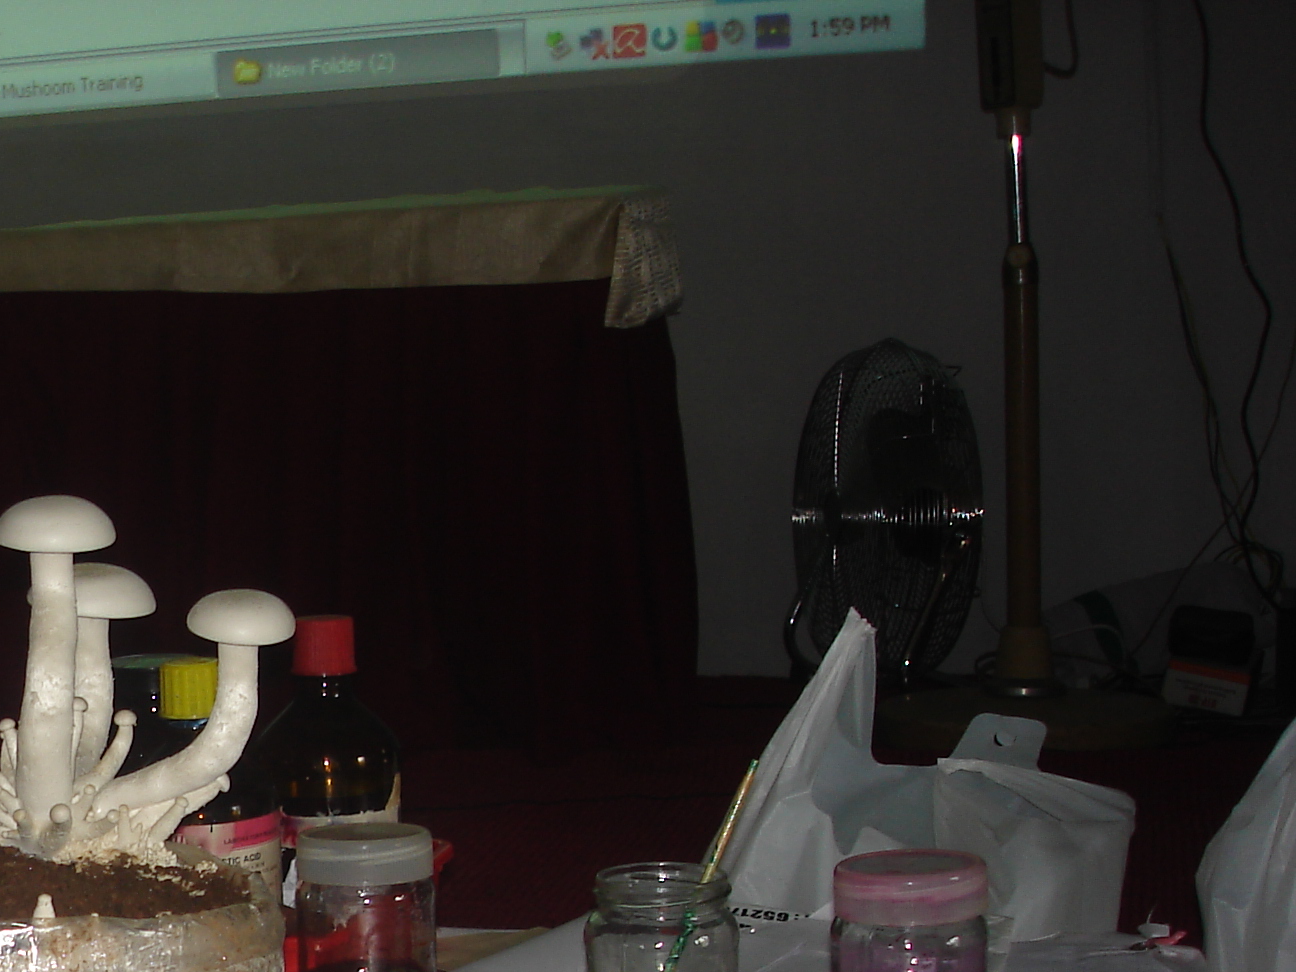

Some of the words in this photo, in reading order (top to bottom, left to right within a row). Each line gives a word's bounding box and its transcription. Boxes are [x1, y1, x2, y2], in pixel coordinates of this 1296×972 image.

[811, 17, 855, 38] 1:59
[860, 14, 891, 33] PM
[267, 62, 304, 79] New
[310, 56, 363, 75] Folder
[2, 81, 76, 99] Mushoom
[81, 74, 144, 95] Training
[244, 852, 262, 862] ACID
[726, 906, 790, 922] 65217
